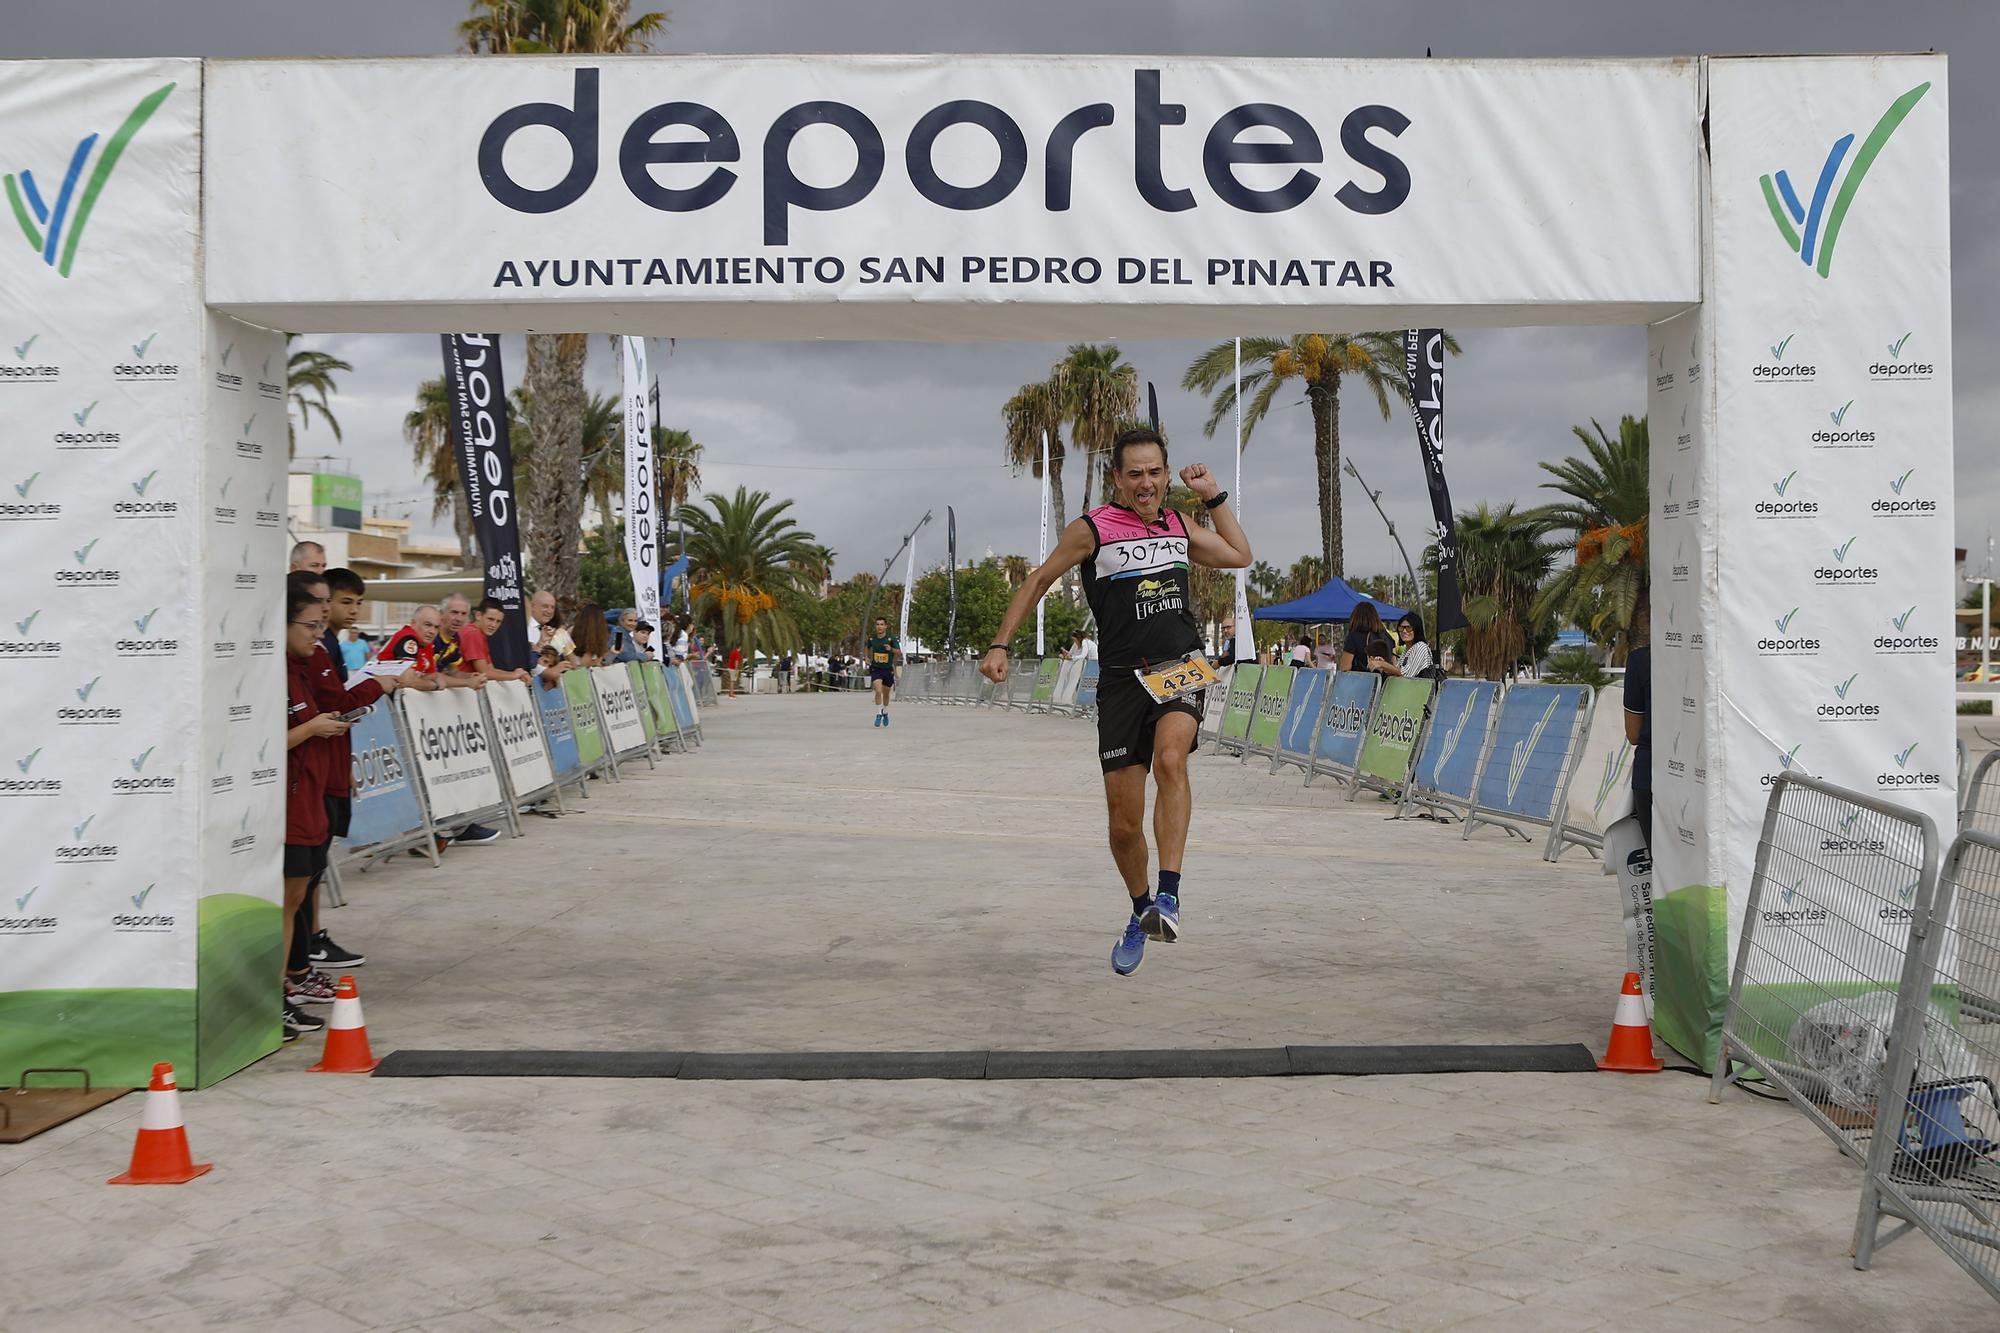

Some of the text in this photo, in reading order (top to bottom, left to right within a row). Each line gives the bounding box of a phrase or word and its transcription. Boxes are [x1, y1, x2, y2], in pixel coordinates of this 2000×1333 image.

[478, 68, 1412, 246] deportes
[493, 256, 1395, 288] AYUNTAMIENTO SAN PEDRO DEL PINATAR
[113, 363, 179, 377] deportes
[1752, 364, 1816, 378] deportes
[1869, 362, 1933, 376] deportes
[54, 431, 120, 446] deportes
[1811, 430, 1875, 444] deportes
[113, 500, 178, 514] deportes
[1755, 501, 1818, 515] deportes
[1871, 499, 1936, 513] deportes
[1116, 541, 1186, 567] 30740
[55, 568, 120, 583] deportes
[1814, 566, 1879, 581] deportes
[116, 638, 178, 652] deportes
[1757, 637, 1820, 651] deportes
[1874, 635, 1939, 649] deportes
[1163, 669, 1204, 689] 425
[57, 706, 121, 720] deportes
[1817, 703, 1880, 717] deportes
[420, 714, 486, 769] deportes
[351, 737, 403, 801] portes
[112, 776, 176, 790] deportes
[1877, 772, 1940, 786] deportes
[55, 843, 118, 858] deportes
[112, 913, 175, 928] deportes
[1879, 906, 1914, 921] depo
[1637, 930, 1645, 942] de
